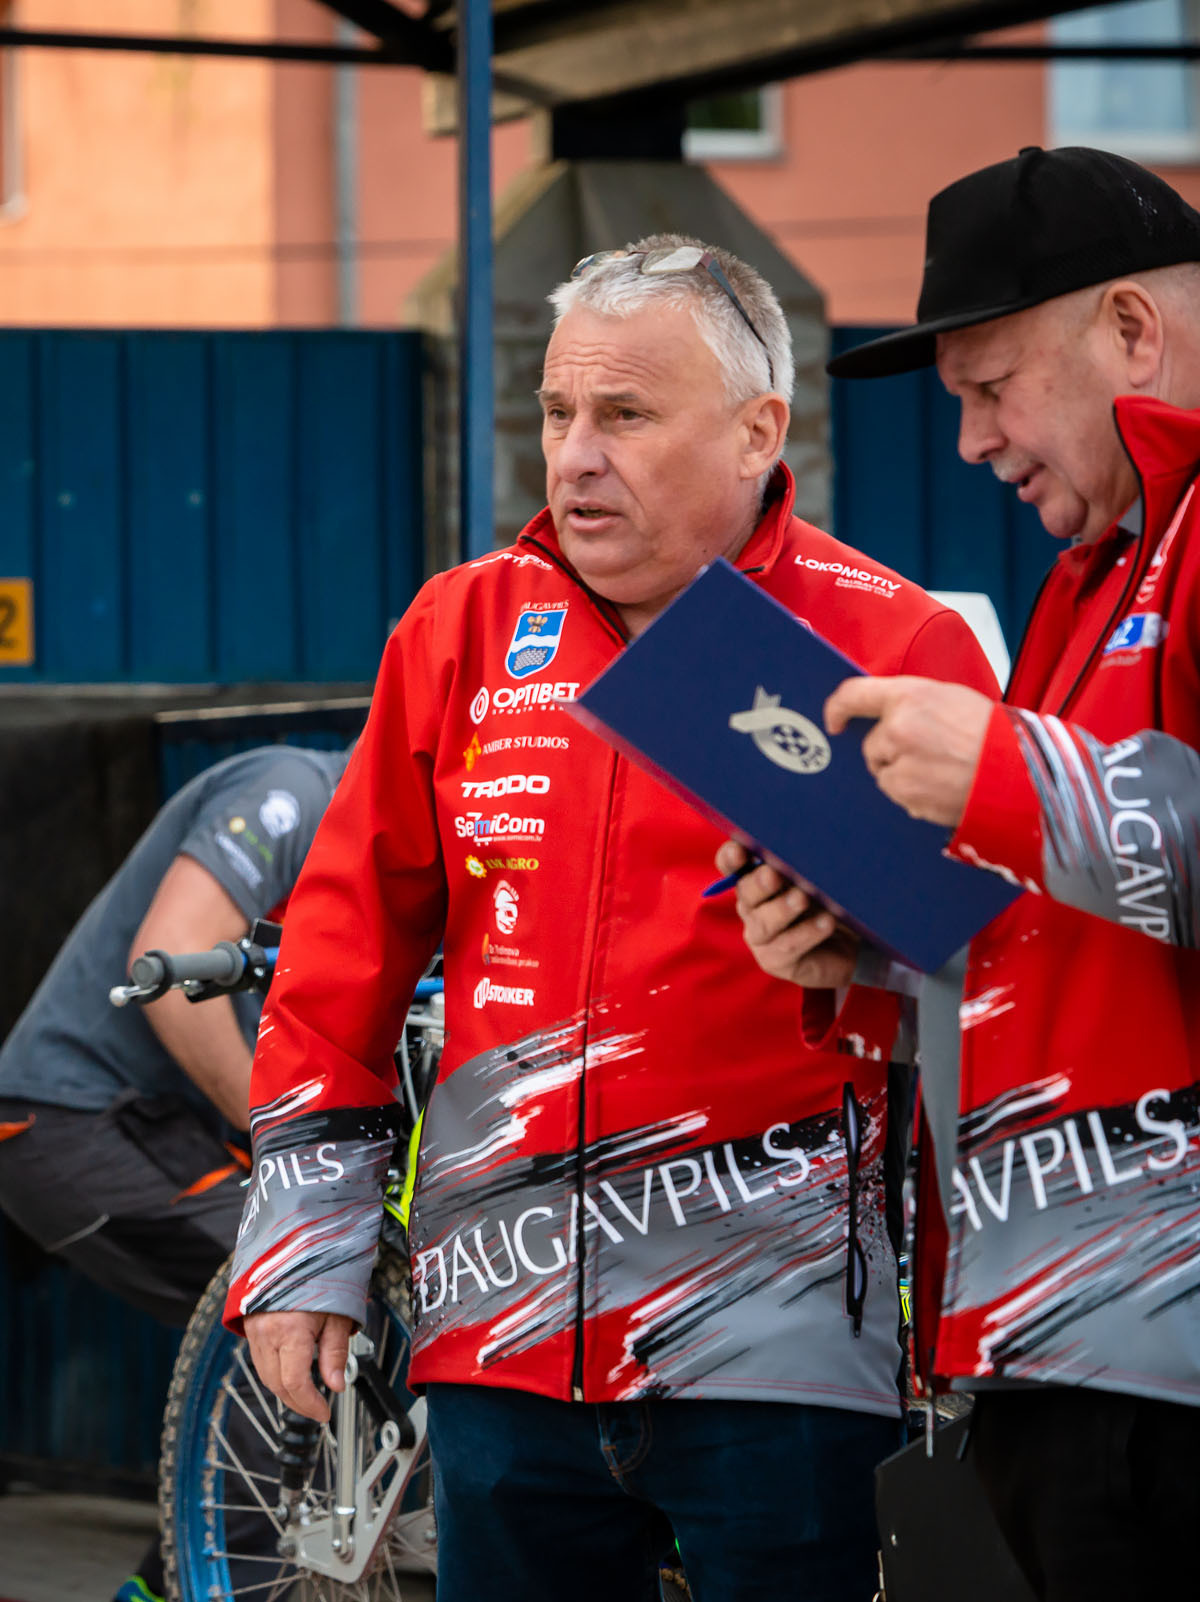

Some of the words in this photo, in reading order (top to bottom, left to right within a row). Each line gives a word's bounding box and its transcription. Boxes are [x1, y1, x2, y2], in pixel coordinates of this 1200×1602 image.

[794, 555, 901, 590] LOKOMOTIV
[492, 682, 580, 708] OPTIBET
[482, 737, 512, 755] AMBER
[513, 736, 570, 749] STUDIOS
[461, 774, 550, 798] TRODO
[415, 1122, 810, 1314] DAUGAVPILS
